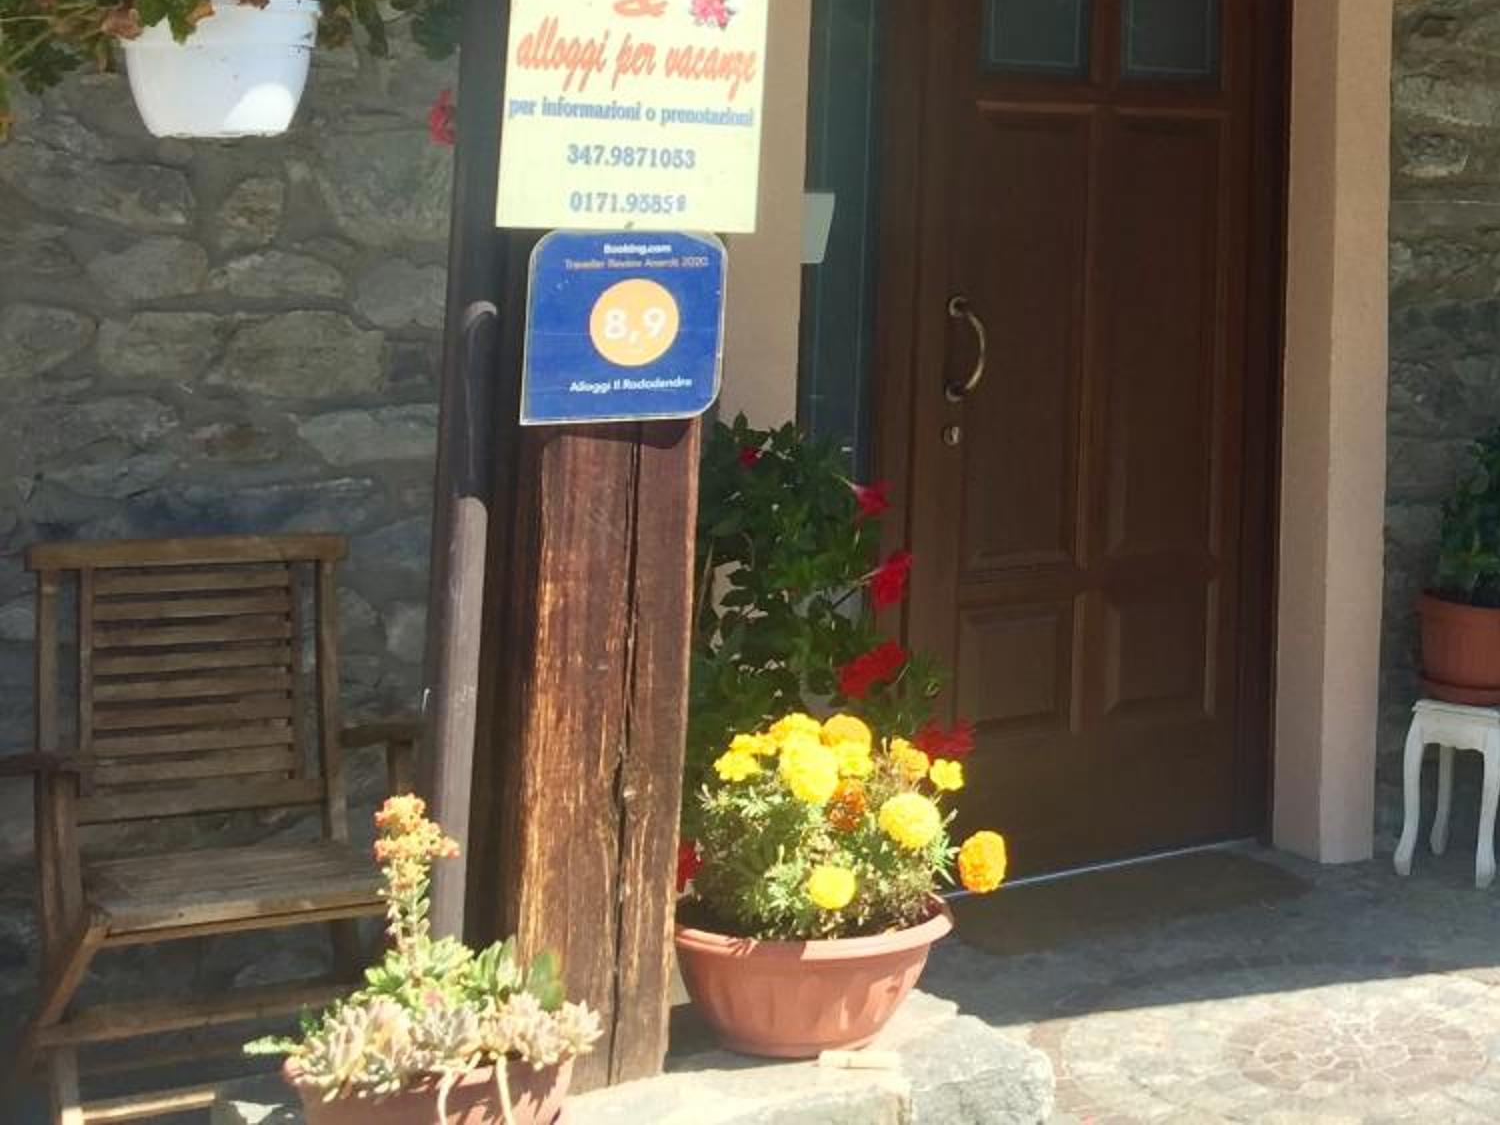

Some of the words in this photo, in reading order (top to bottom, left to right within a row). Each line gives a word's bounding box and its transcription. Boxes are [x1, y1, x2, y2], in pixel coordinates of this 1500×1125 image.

[516, 17, 607, 92] alloggi
[612, 34, 656, 91] per
[665, 45, 756, 102] vacanze
[508, 99, 536, 119] per
[542, 96, 641, 121] informazioni
[646, 109, 656, 119] o
[660, 109, 753, 127] prenotazioni
[567, 144, 696, 169] 347.9871053
[603, 243, 671, 255] Booking.com
[604, 307, 668, 343] 8,9
